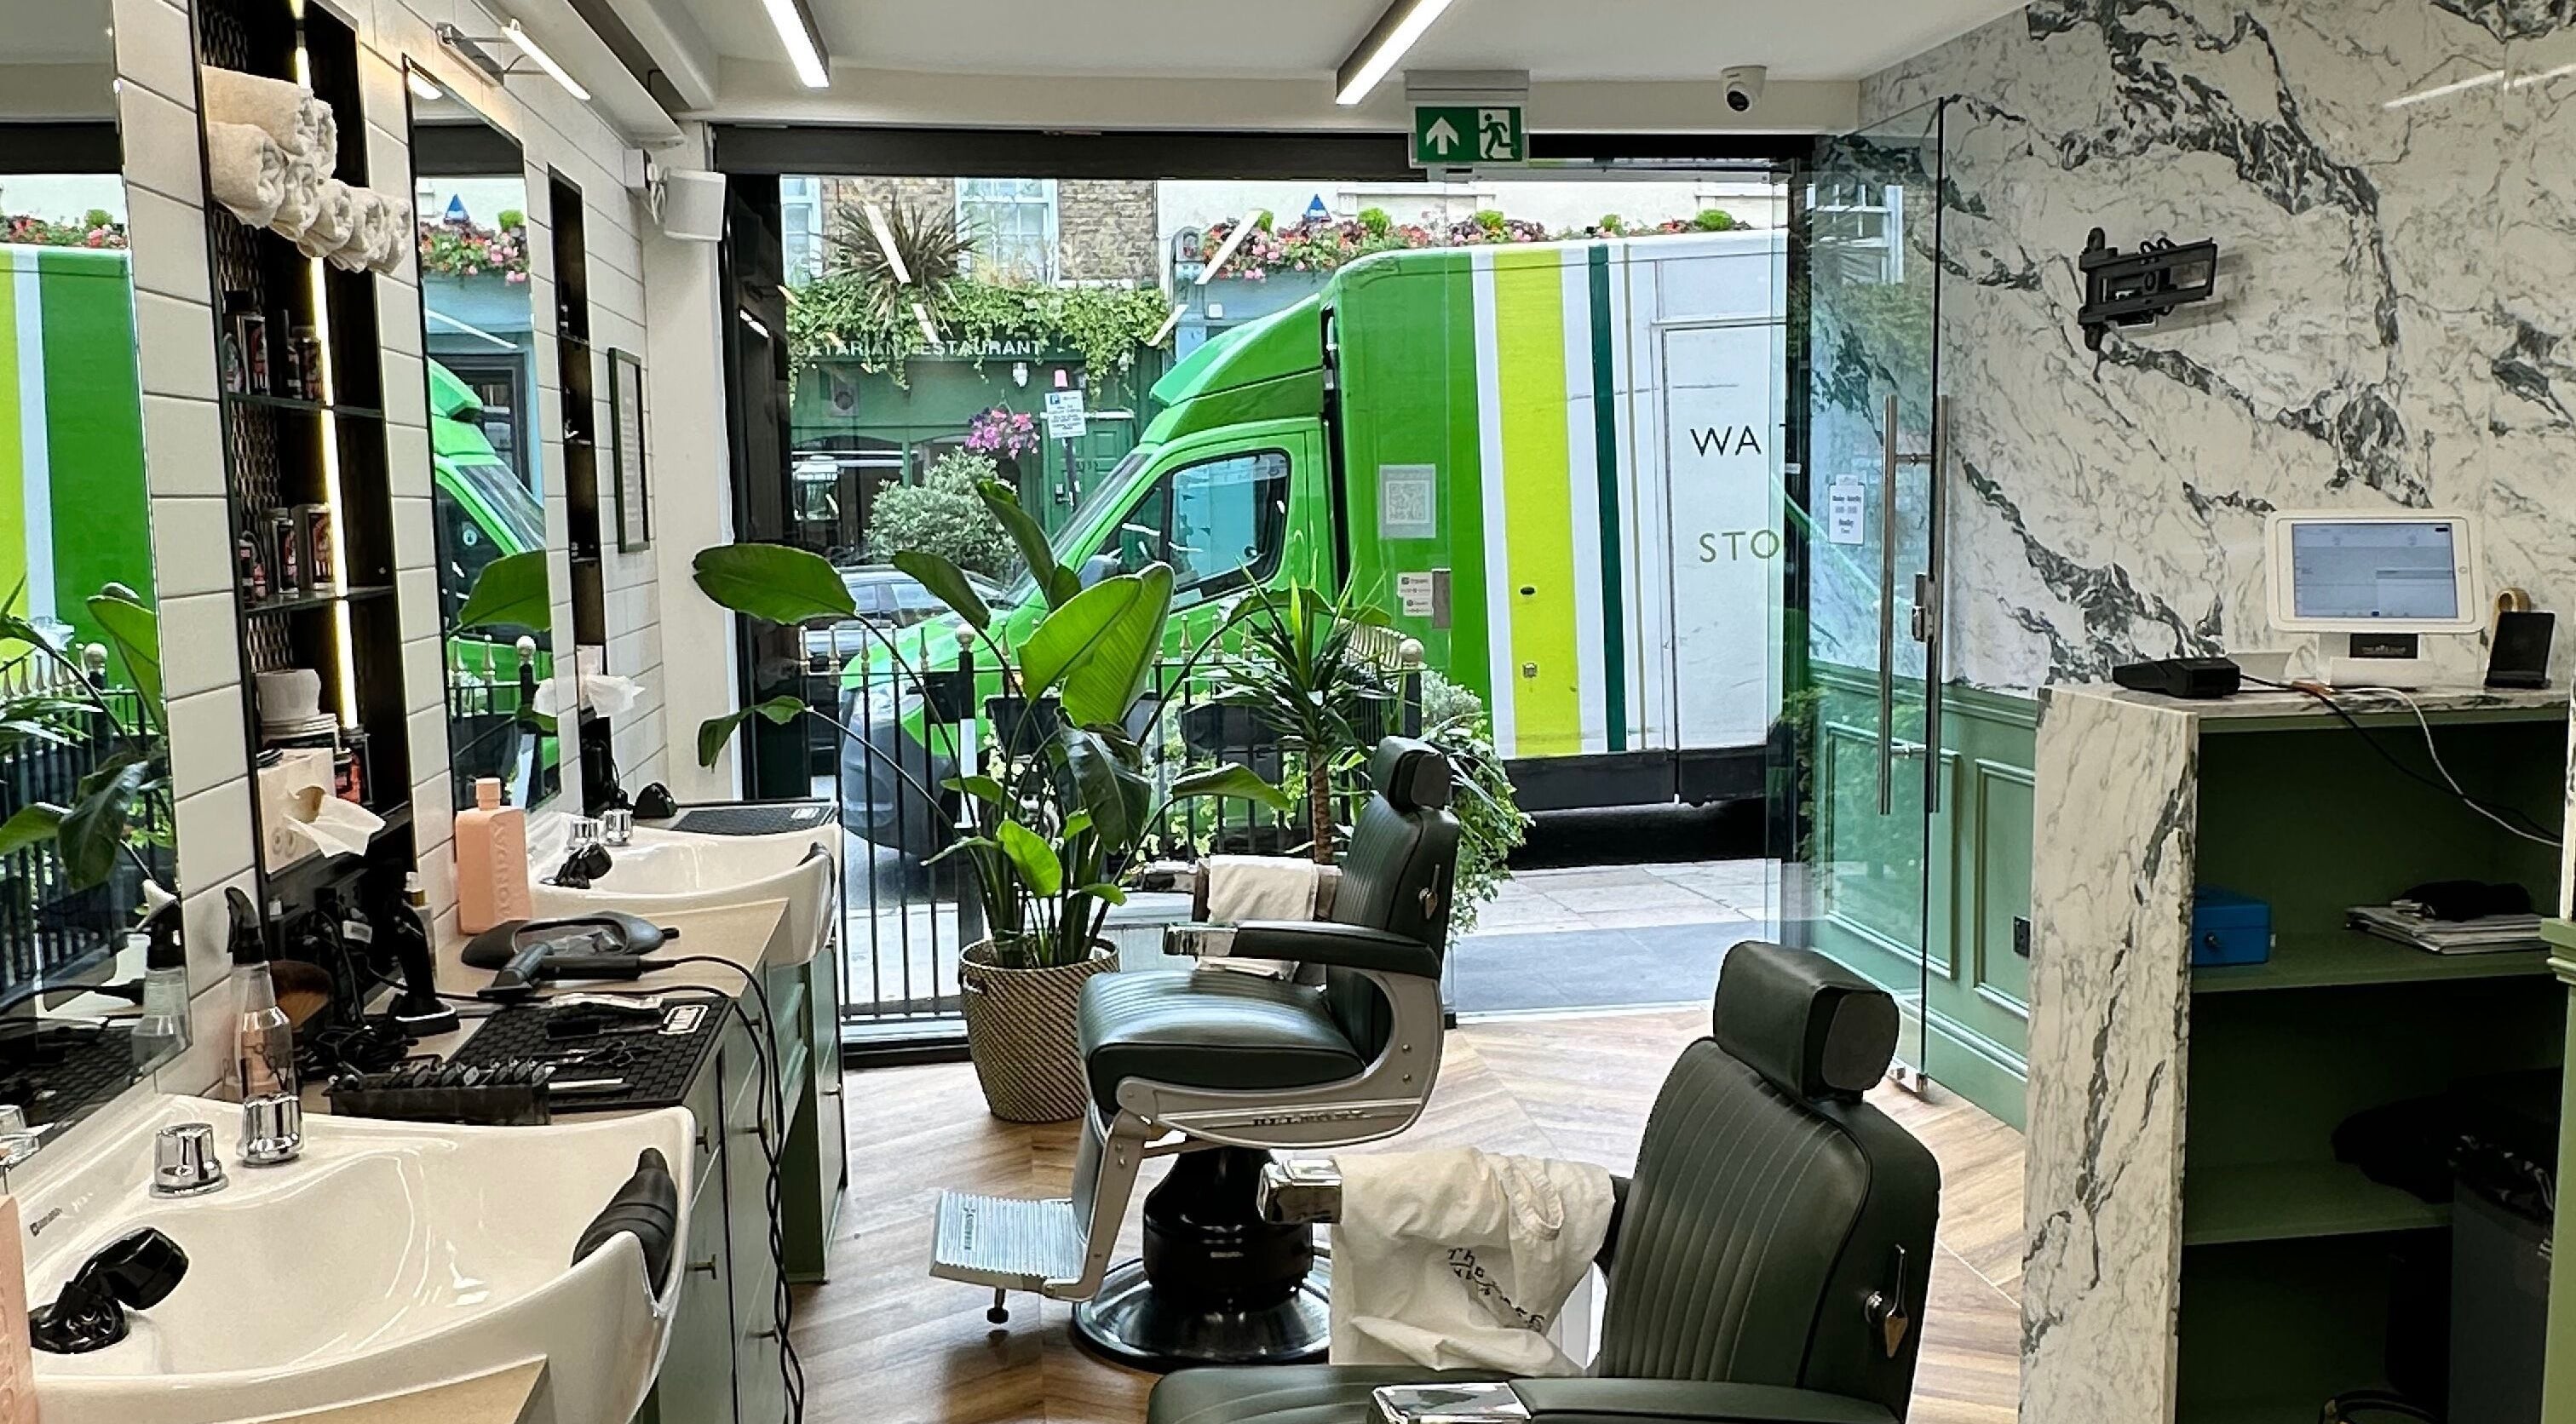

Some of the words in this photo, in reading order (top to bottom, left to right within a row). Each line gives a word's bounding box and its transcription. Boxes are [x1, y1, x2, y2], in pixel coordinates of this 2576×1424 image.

[908, 339, 1042, 357] ESTAURANT
[1690, 424, 1785, 456] WA
[1699, 530, 1780, 562] STO
